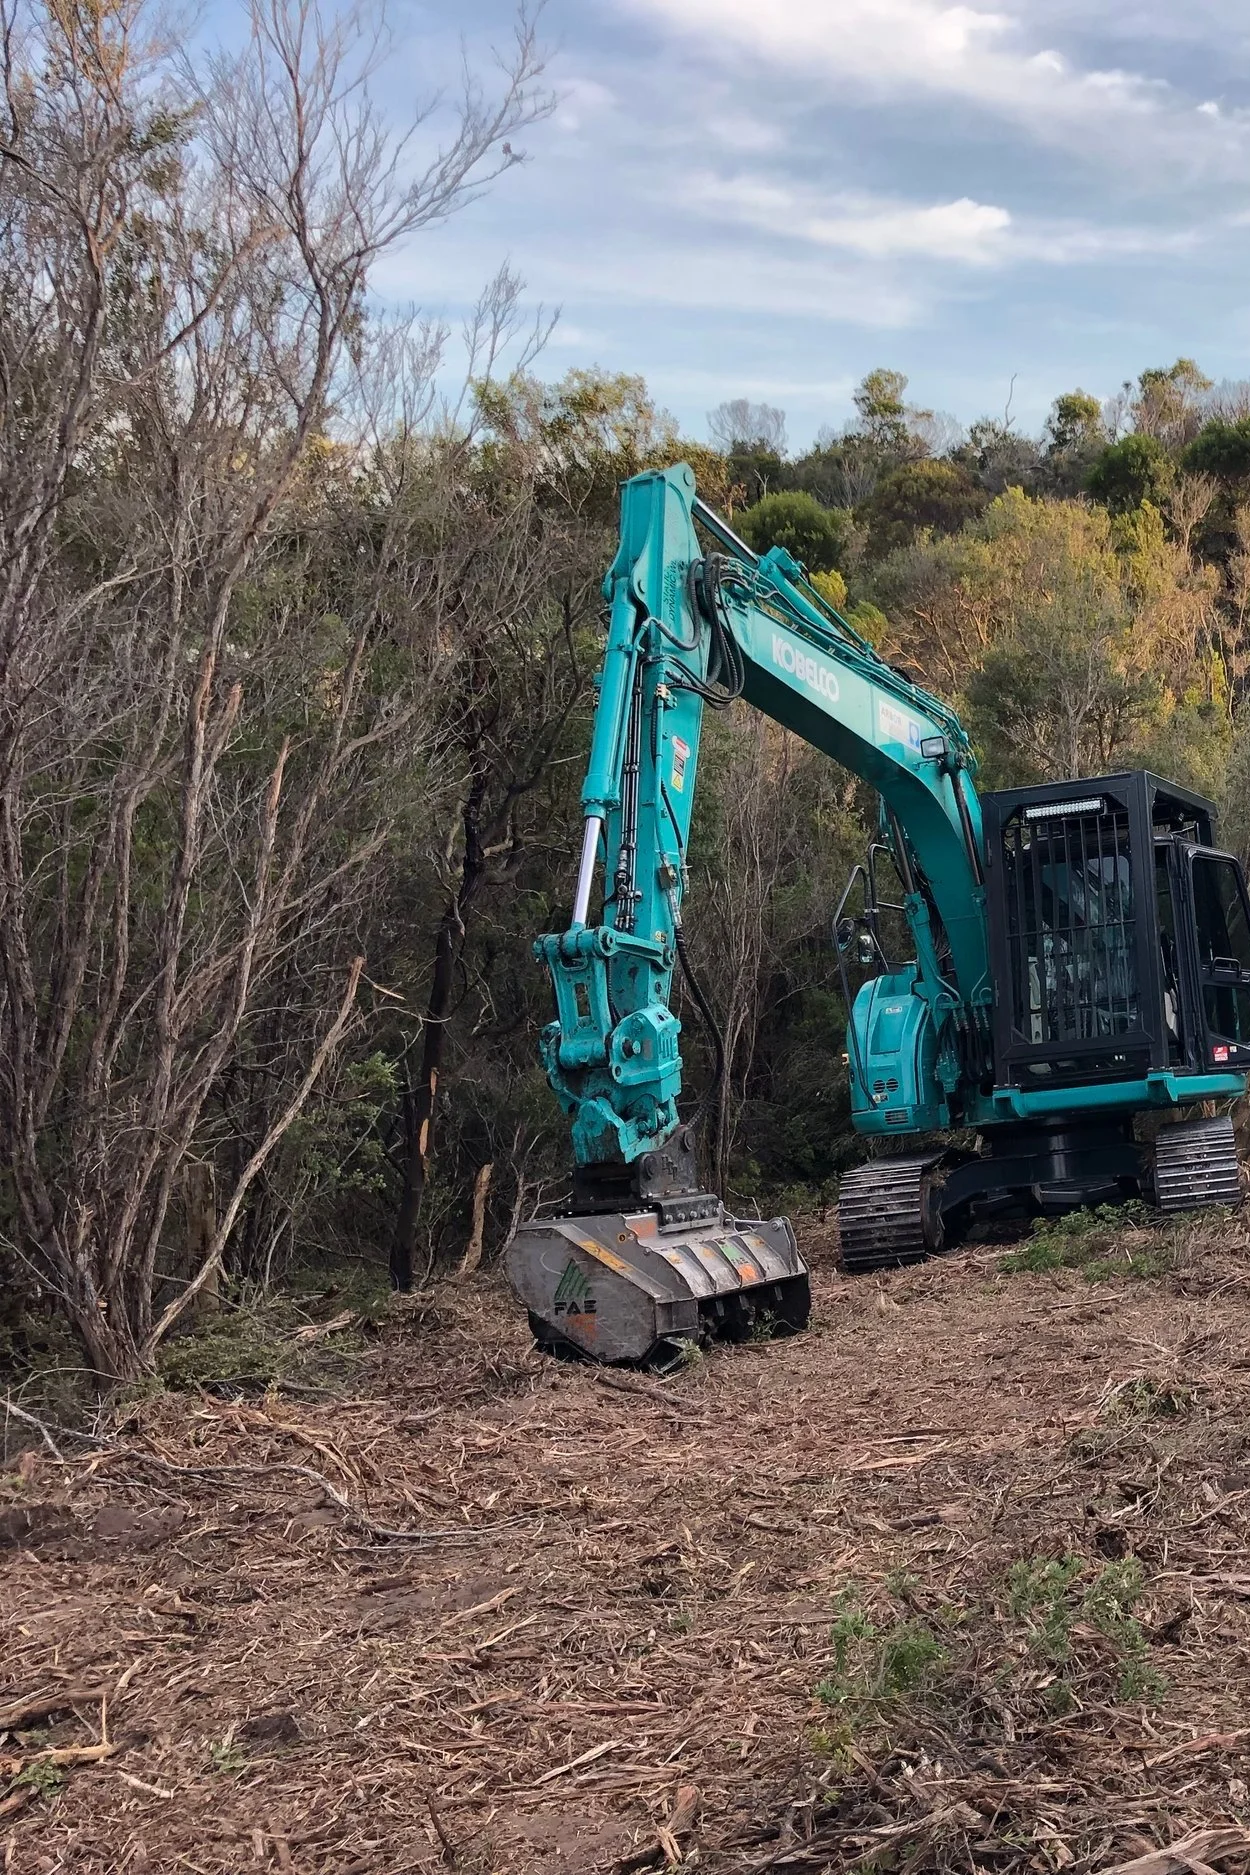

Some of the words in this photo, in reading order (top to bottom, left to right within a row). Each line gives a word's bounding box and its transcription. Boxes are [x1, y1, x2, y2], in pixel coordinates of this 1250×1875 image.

[668, 574, 677, 621] DYNAMIC
[772, 634, 840, 702] KOBELCO
[554, 1300, 597, 1315] FAE
